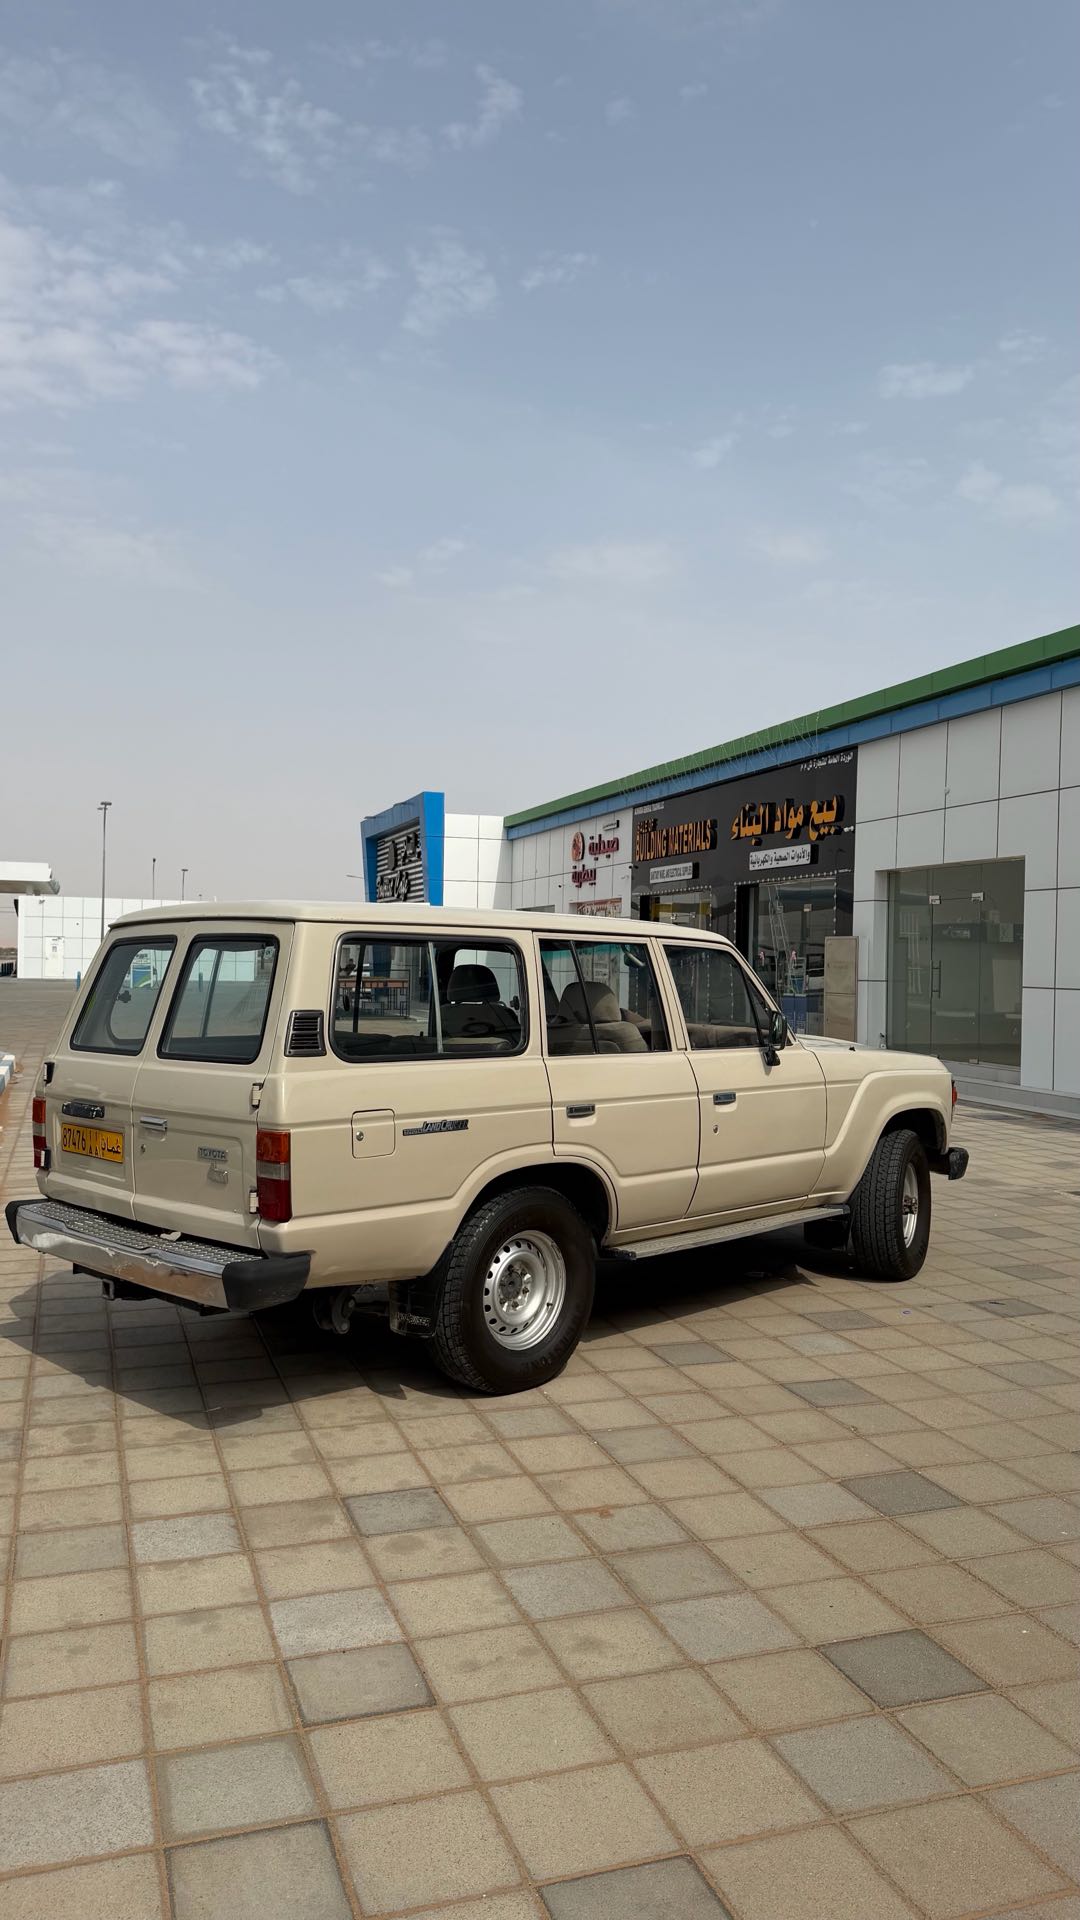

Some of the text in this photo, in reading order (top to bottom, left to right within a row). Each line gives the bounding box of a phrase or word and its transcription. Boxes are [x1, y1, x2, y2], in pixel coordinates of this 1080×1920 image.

[730, 795, 838, 846] بيع مواد البناء
[588, 834, 619, 861] صيدلية
[636, 819, 711, 861] BUILDING MATERIALS
[62, 1127, 87, 1151] 87476
[198, 1147, 226, 1160] TOYOTA
